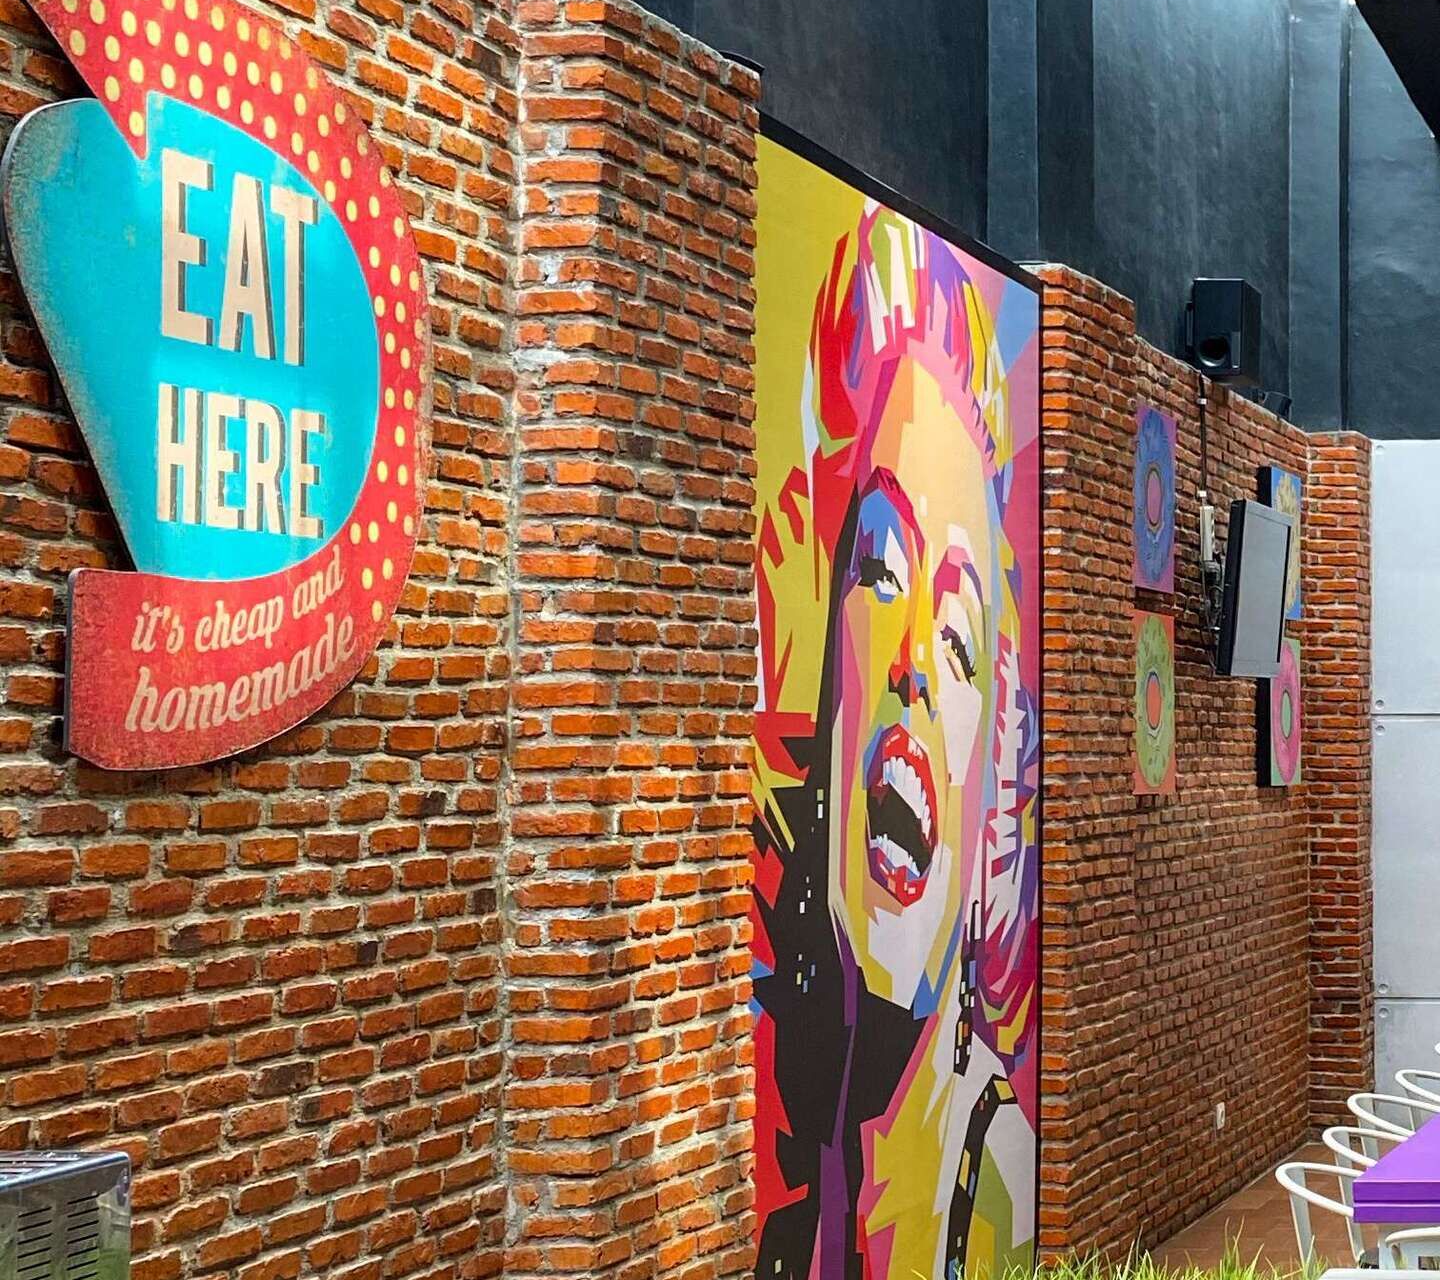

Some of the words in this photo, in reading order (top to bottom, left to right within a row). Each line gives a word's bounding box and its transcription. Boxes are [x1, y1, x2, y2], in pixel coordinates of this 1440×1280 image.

[160, 147, 319, 367] EAT
[156, 382, 326, 540] HERE
[130, 600, 185, 654] it's
[194, 599, 284, 653] cheap
[291, 543, 348, 620] and
[124, 611, 358, 734] homemade
